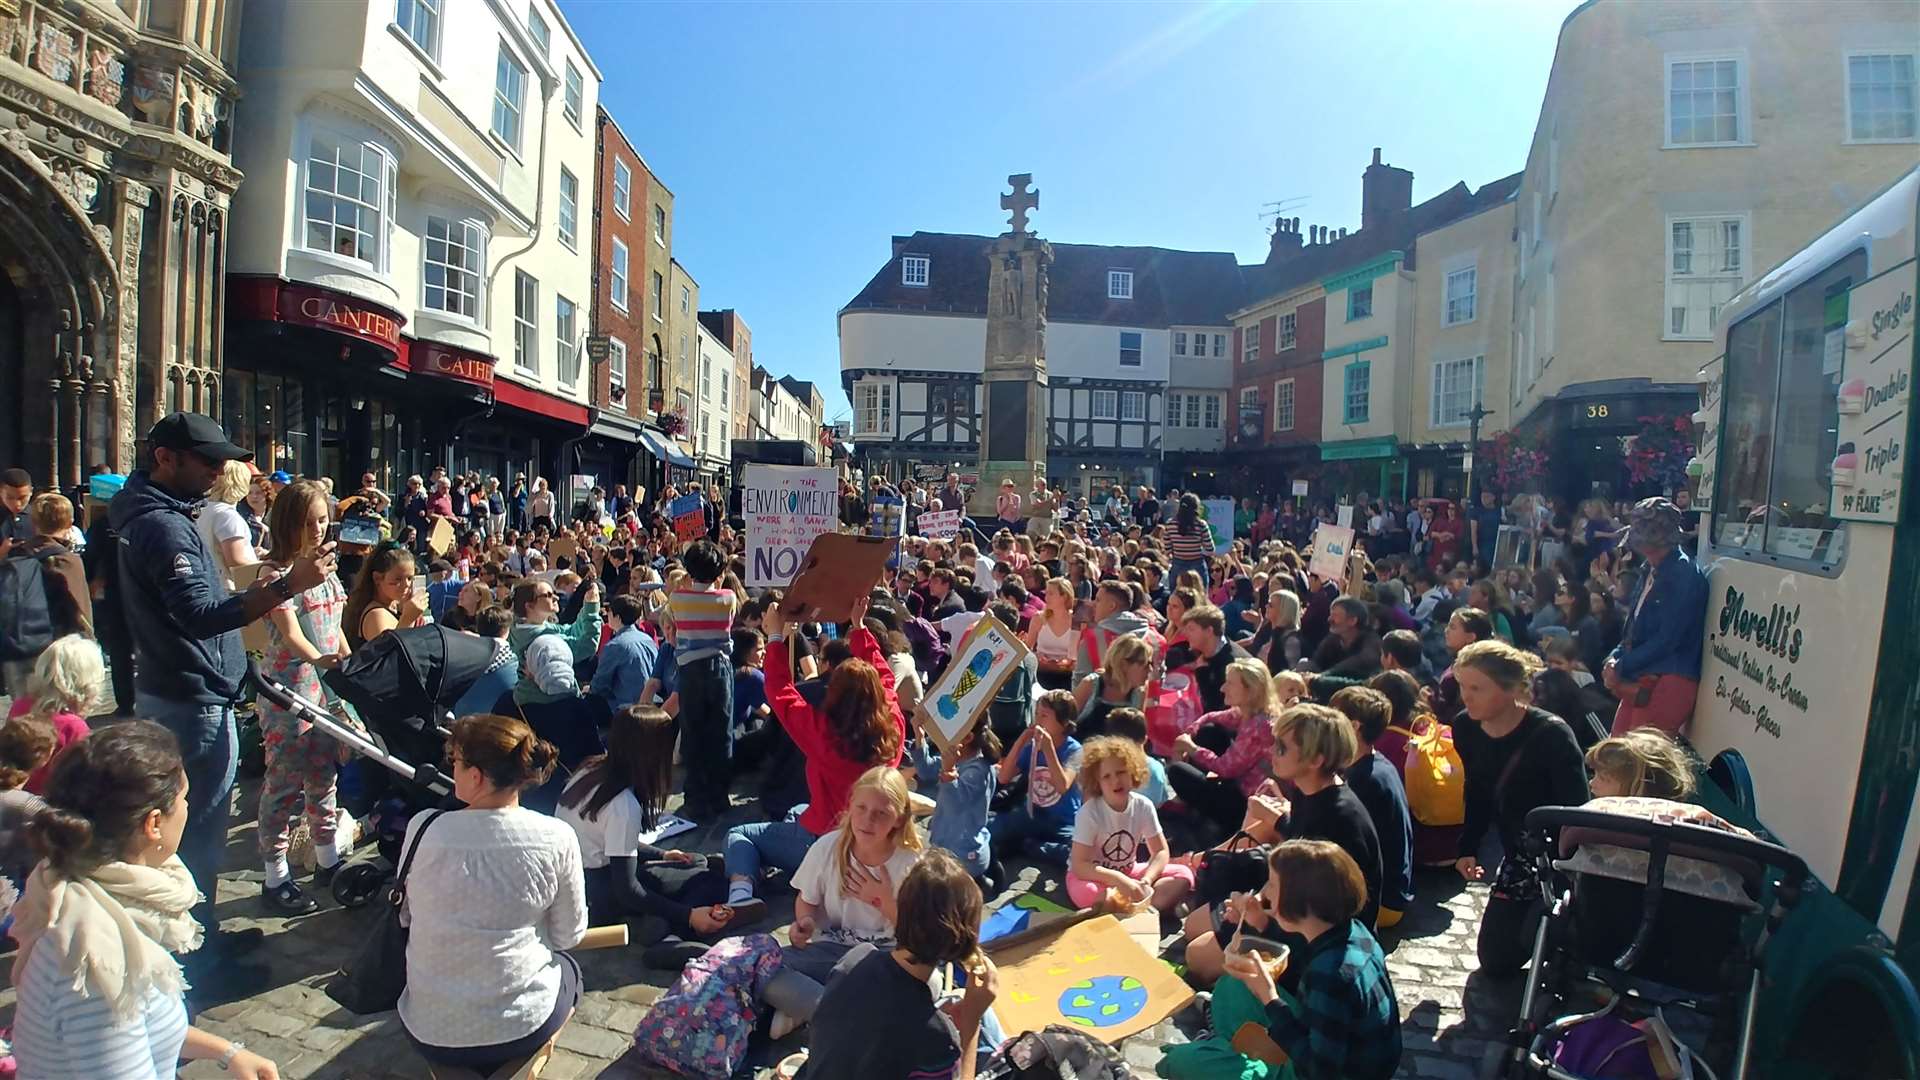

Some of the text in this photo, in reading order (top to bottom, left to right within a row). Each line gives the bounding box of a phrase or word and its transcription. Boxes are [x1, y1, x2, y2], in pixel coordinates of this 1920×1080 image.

[1871, 291, 1912, 341] Single
[1863, 369, 1908, 414] Double
[1587, 404, 1608, 418] 38
[1864, 438, 1900, 475] Triple
[800, 478, 818, 488] THE
[747, 488, 836, 516] ENVIRONMENT
[1855, 495, 1881, 514] FLAKE
[756, 515, 782, 525] WERE
[804, 516, 828, 526] BANK
[771, 527, 806, 536] WOULD
[755, 547, 807, 581] NO
[1719, 584, 1803, 664] Morelli's
[1742, 651, 1764, 686] Italian
